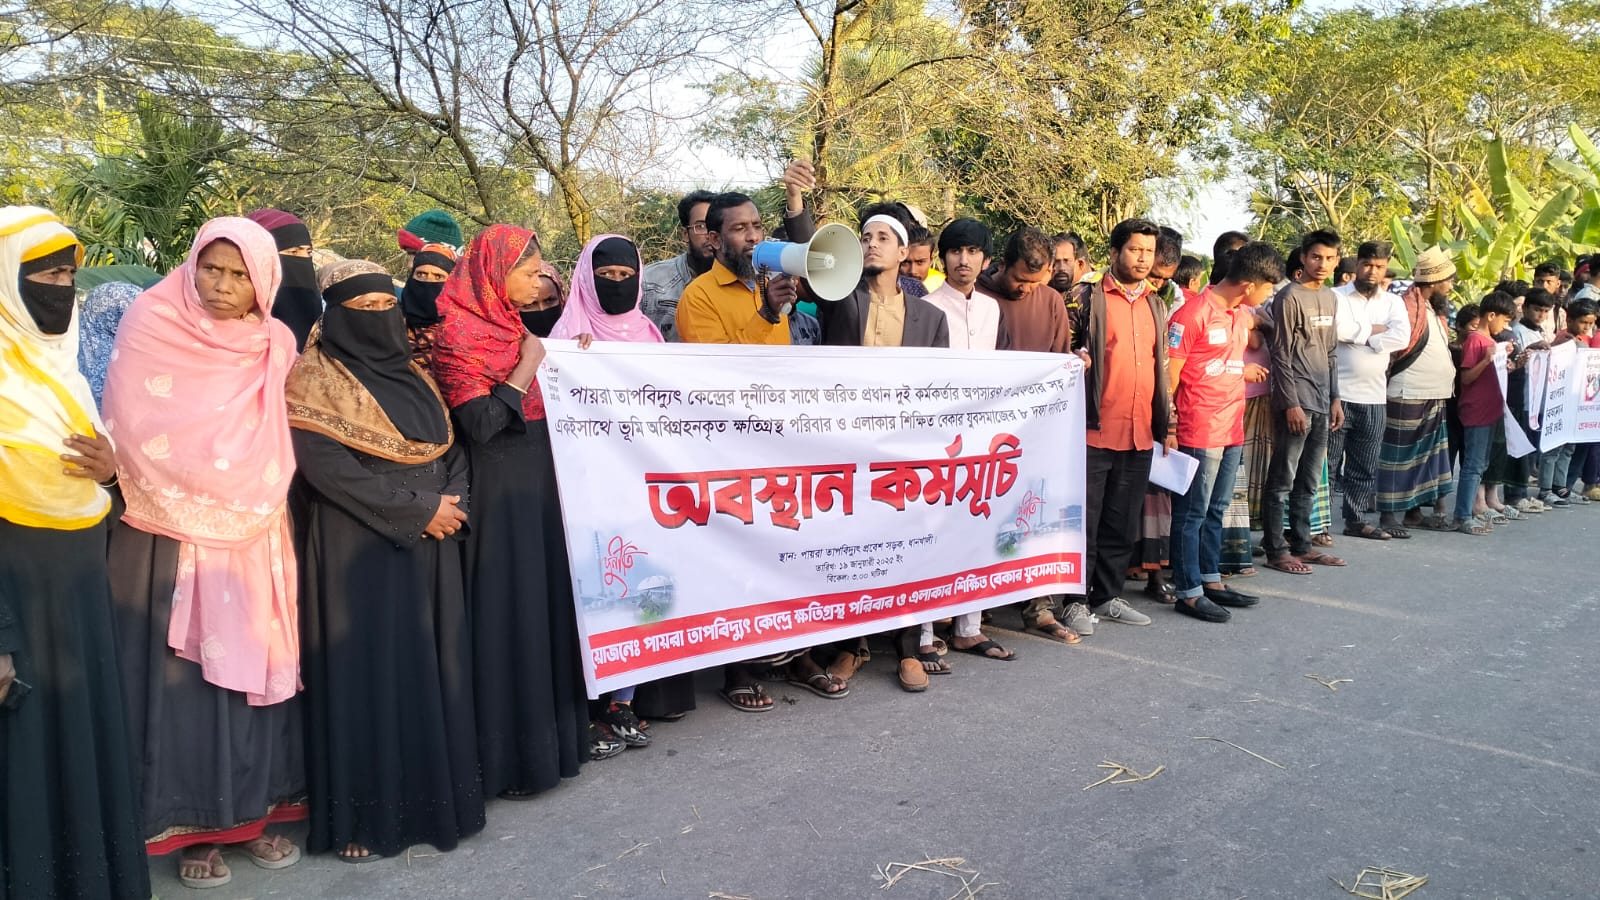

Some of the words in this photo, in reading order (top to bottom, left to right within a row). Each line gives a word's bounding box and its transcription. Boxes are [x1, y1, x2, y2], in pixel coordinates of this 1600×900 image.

[570, 385, 612, 405] পায়রা
[613, 384, 682, 409] তাপবিদ্যুৎ
[688, 389, 736, 407] কেন্দ্রের
[739, 383, 787, 409] দূর্নীতির
[790, 388, 820, 404] সাথে
[823, 384, 858, 403] জরিত
[862, 386, 891, 402] প্রধান
[895, 383, 911, 405] দুই
[915, 382, 960, 402] কর্মকর্তার
[962, 385, 1003, 401] অপসারণ
[555, 414, 613, 438] একইসাথে
[618, 415, 644, 443] ভূমি
[646, 415, 729, 442] অধিগ্রহনকৃত
[732, 415, 785, 437] ক্ষতিগ্রস্থ
[789, 413, 831, 433] পরিবার
[837, 418, 846, 430] ও
[851, 414, 896, 431] এলাকার
[899, 410, 935, 430] শিক্ষিত
[938, 412, 964, 429] বেকার
[967, 408, 1016, 431] যুবসমাজের
[645, 463, 858, 531] অবস্থান
[868, 432, 1022, 519] কর্মসূচি
[801, 548, 823, 560] পায়রা
[826, 543, 861, 557] তাপবিদ্যুৎ
[863, 543, 884, 553] প্রবেশ
[643, 630, 684, 653] পায়রা
[687, 617, 751, 643] তাপবিদ্যুৎ
[754, 610, 792, 635] কেন্দ্রে
[794, 601, 845, 624] ক্ষতিগ্রস্থ
[848, 594, 895, 616] পরিবার
[896, 594, 906, 606] ও
[908, 584, 952, 605] এলাকার
[954, 574, 988, 596] শিক্ষিত
[990, 568, 1022, 590] বেকার
